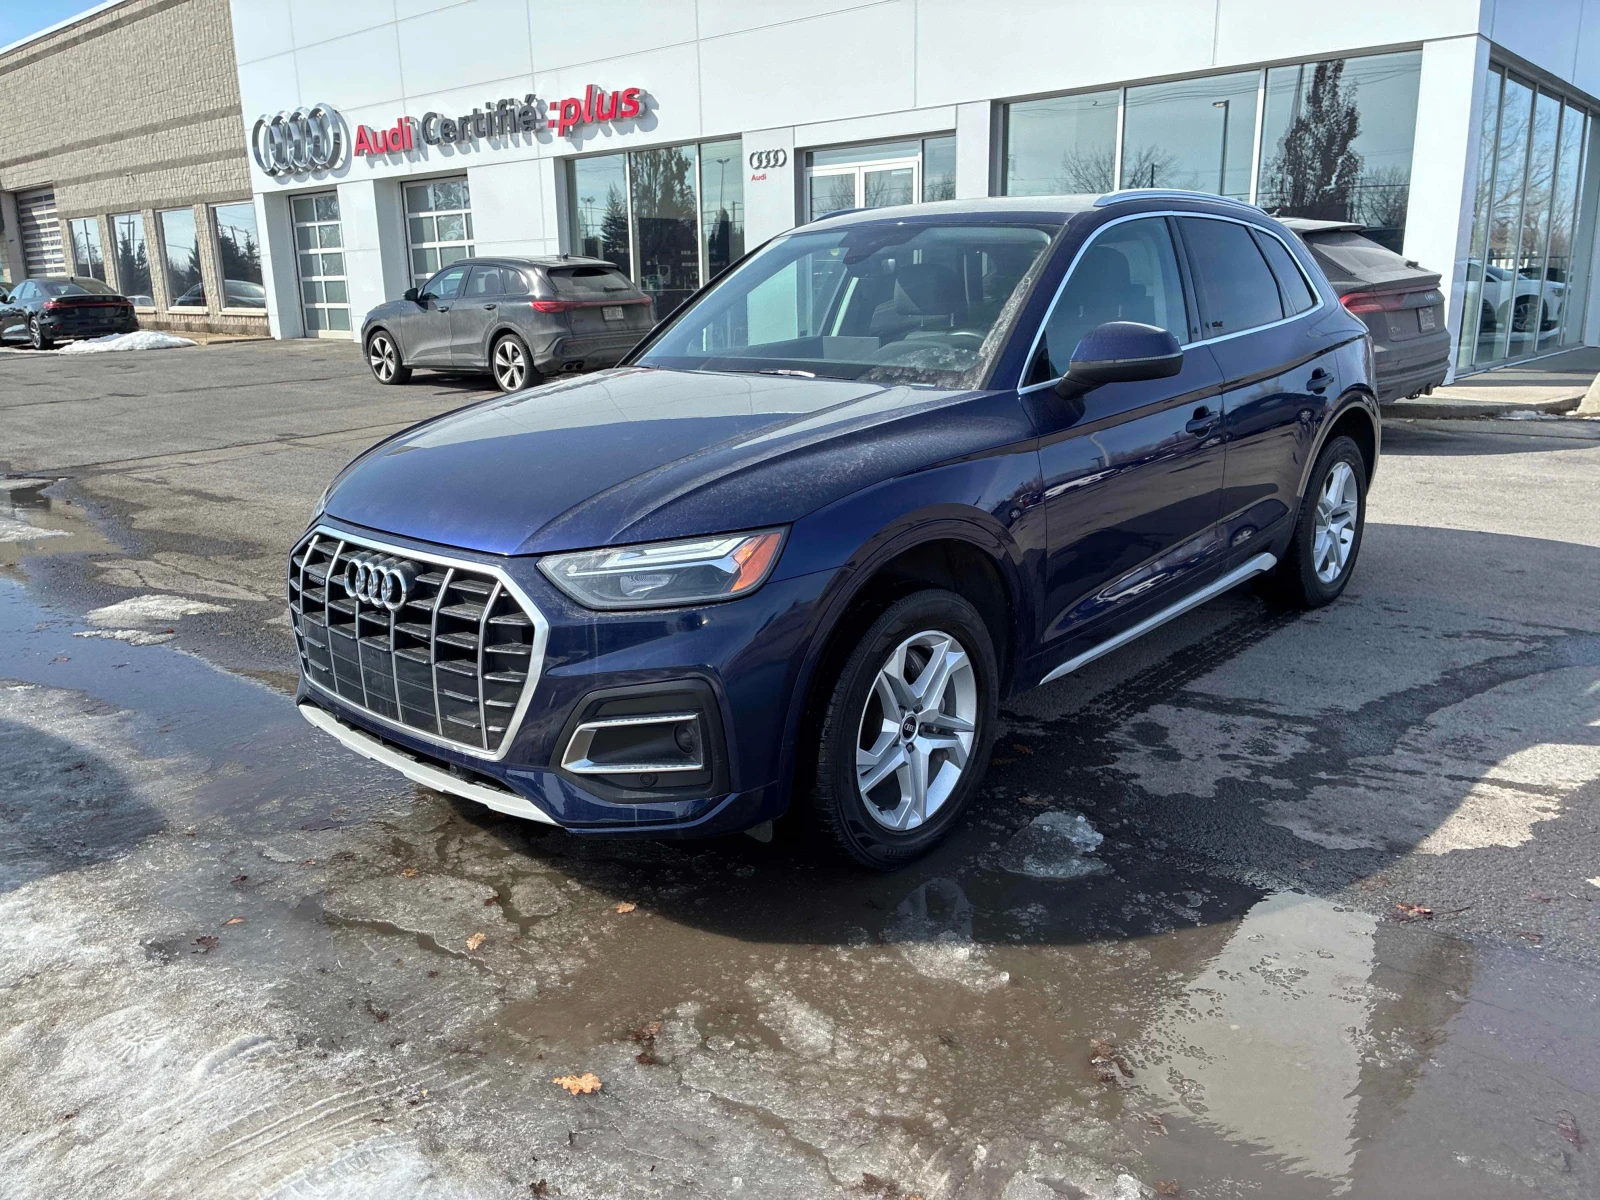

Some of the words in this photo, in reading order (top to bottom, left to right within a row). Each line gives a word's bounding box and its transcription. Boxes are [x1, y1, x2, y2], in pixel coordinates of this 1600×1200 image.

[354, 116, 413, 157] Audi
[421, 93, 538, 146] Certifié
[751, 173, 767, 182] Audi
